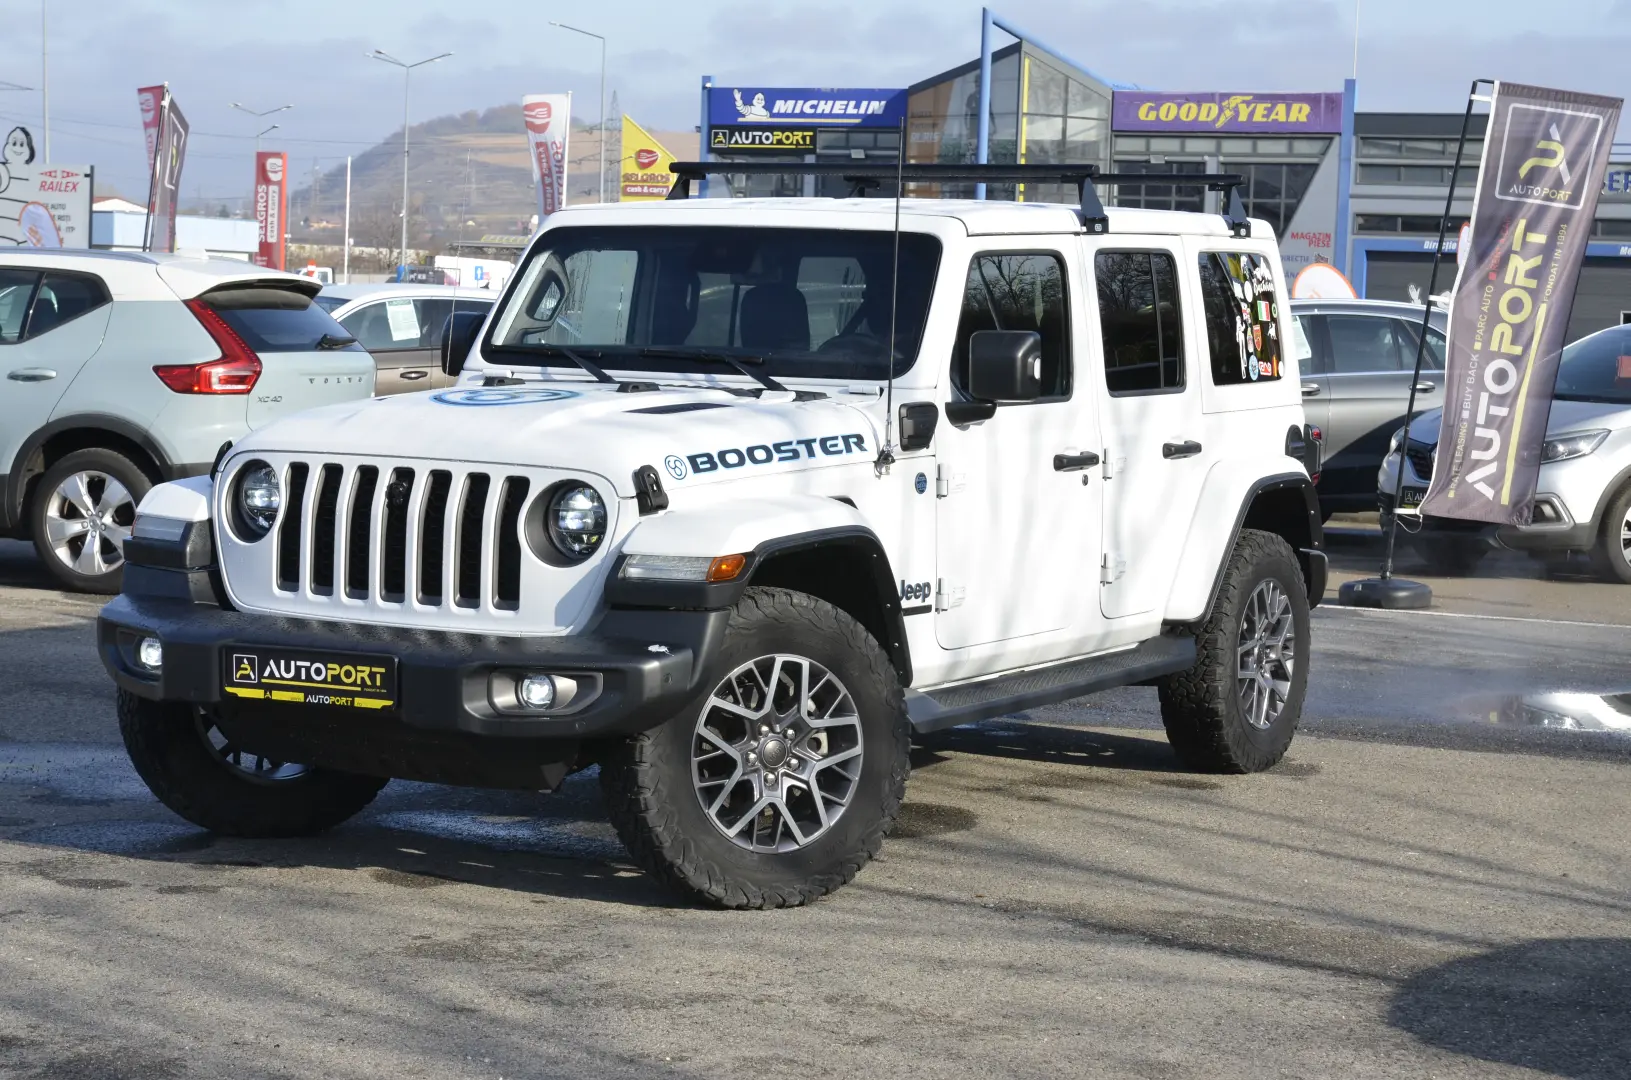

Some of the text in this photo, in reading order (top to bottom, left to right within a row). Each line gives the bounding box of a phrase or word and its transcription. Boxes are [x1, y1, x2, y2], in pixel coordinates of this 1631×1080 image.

[772, 100, 887, 115] MICHELIN
[730, 131, 814, 145] AUTOPORT
[39, 181, 80, 192] RAILEX
[622, 172, 671, 184] SELGROS
[649, 187, 668, 195] carry
[1510, 184, 1572, 201] AUTOPORT
[256, 184, 267, 243] SELGROS
[1290, 232, 1332, 241] MAGAZIN
[1308, 240, 1331, 248] PIESE
[1543, 224, 1567, 302] FONDAT IN 1994
[1481, 285, 1494, 313] AUTO
[1475, 315, 1489, 343] PARC
[1465, 218, 1548, 501] AUTOPORT
[1466, 353, 1481, 386] BACK
[308, 376, 364, 384] VOLVO
[1463, 386, 1475, 410] BUY
[1455, 421, 1469, 461] LEASING
[686, 433, 868, 475] BOOSTER
[900, 579, 932, 603] Jeep
[263, 658, 386, 687] AUTOPORT
[306, 694, 353, 706] AUTOPORT
